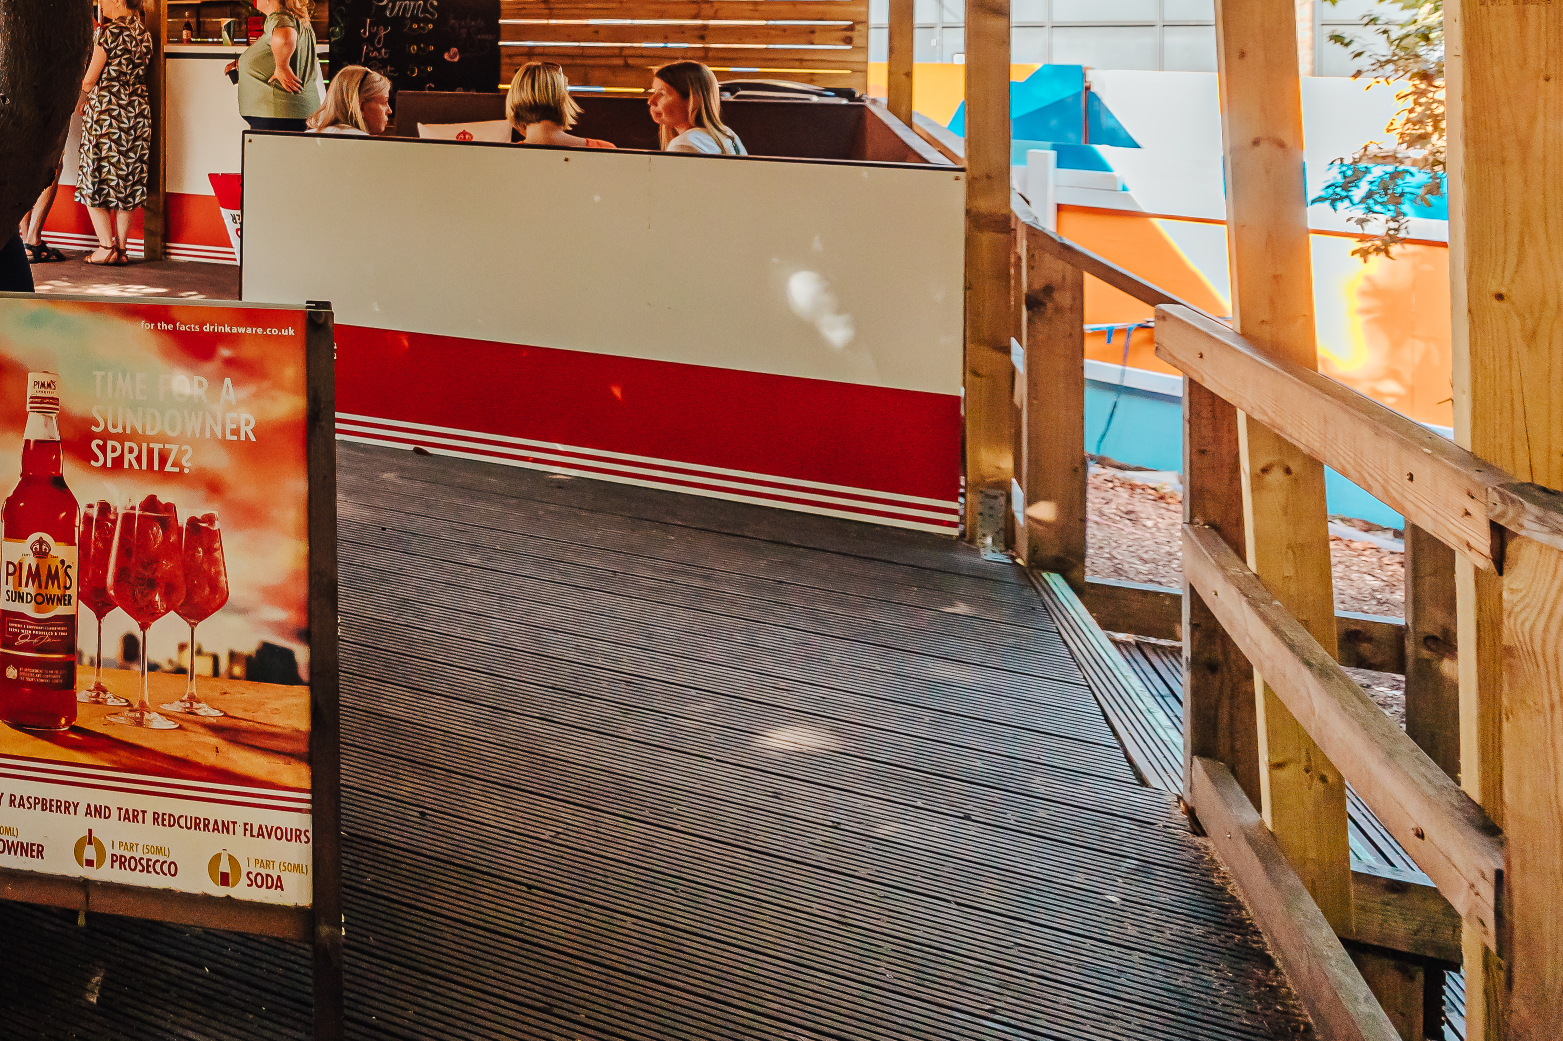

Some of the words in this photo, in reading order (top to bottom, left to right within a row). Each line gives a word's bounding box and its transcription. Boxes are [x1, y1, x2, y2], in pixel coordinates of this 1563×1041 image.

[360, 18, 391, 48] Jug
[141, 320, 155, 330] for
[157, 321, 174, 331] the
[176, 321, 200, 332] facts
[203, 323, 295, 336] drinkaware.co.uk
[33, 380, 57, 390] PIMM'S
[93, 371, 148, 401] TIME
[159, 374, 209, 404] FOR
[220, 377, 236, 405] A
[90, 405, 257, 442] SUNDOWNER
[90, 439, 193, 474] SPRITZ?
[5, 558, 73, 591] PIMM'S
[5, 590, 73, 607] SUNDOWNER
[9, 793, 80, 816] RASPBERRY
[84, 803, 112, 820] AND
[116, 807, 148, 824] TART
[152, 811, 238, 836] REDCURRANT
[243, 822, 311, 845] FLAVOURS
[111, 840, 115, 849] 1
[118, 840, 140, 853] PART
[142, 843, 171, 858] (50ML)
[110, 853, 178, 877] PROSECCO
[246, 857, 250, 867] 1
[254, 858, 276, 870] PART
[278, 861, 309, 876] (50ML)
[246, 870, 285, 892] SODA
